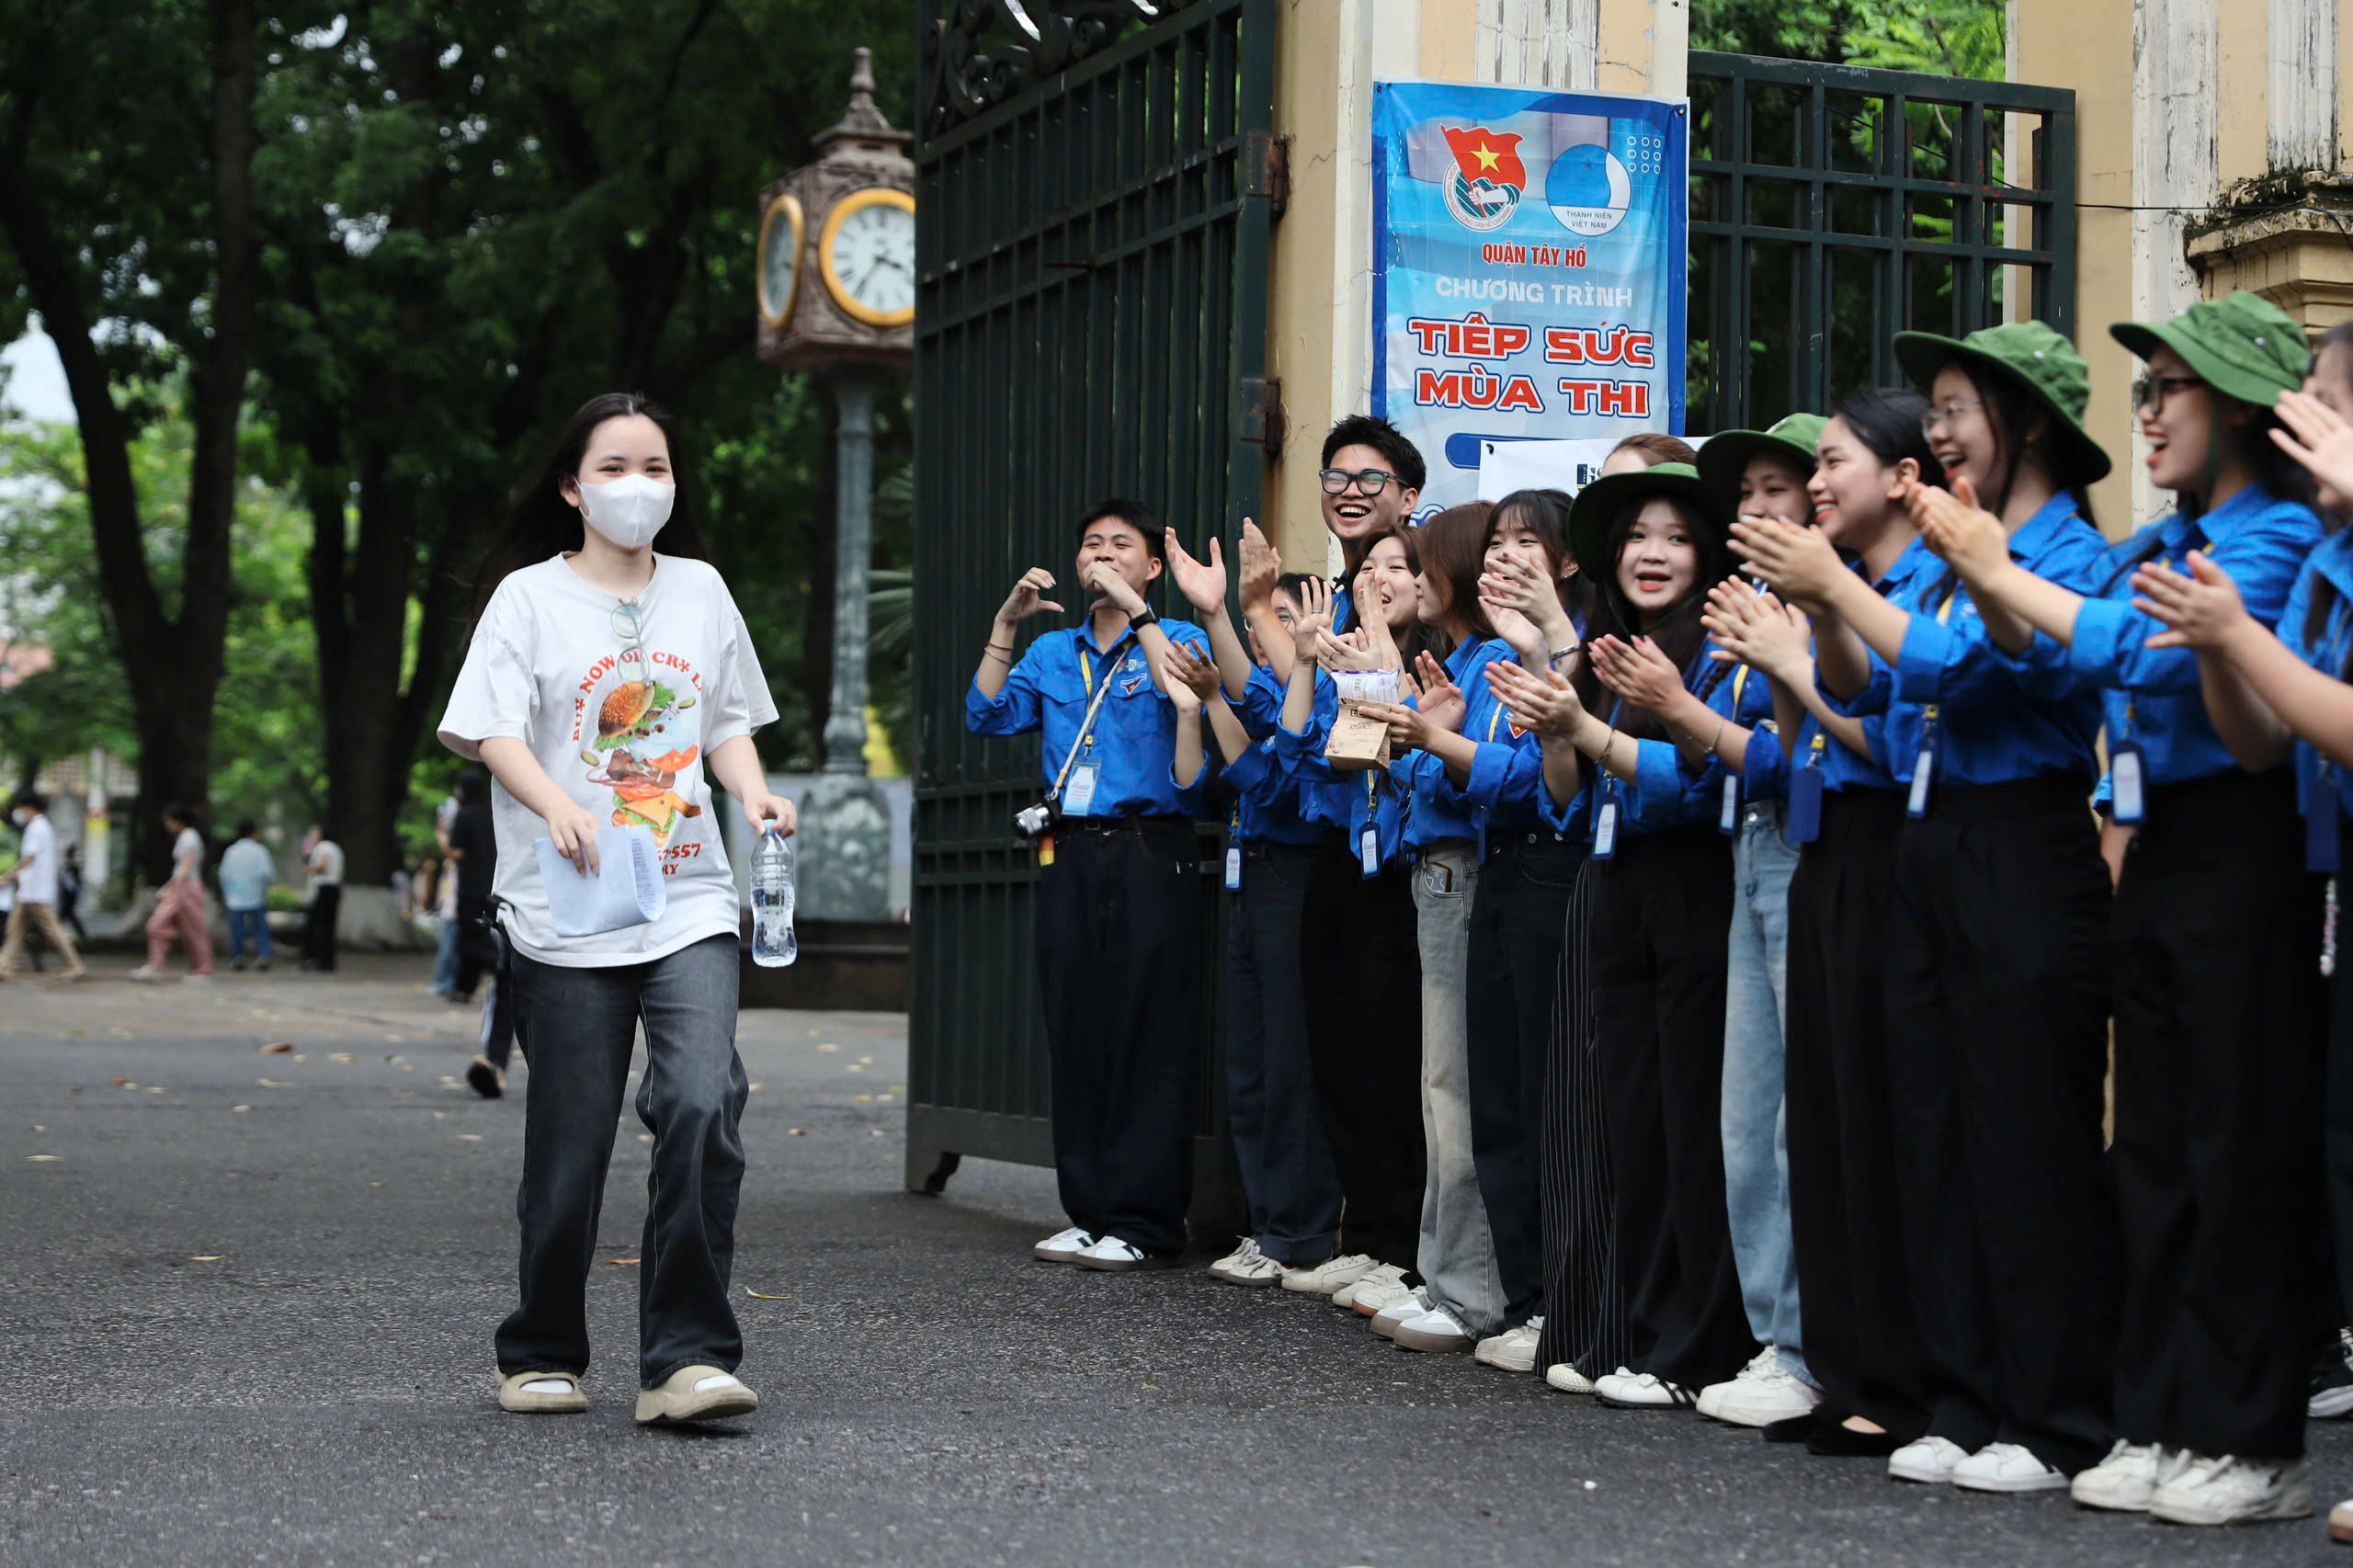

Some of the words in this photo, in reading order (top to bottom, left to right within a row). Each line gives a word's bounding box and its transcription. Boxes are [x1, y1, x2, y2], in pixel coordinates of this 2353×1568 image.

[1595, 211, 1612, 220] NIÊN
[1483, 242, 1526, 267] QUẬN
[1531, 244, 1560, 267] TÂY
[1565, 243, 1587, 268] HỒ
[1435, 277, 1544, 302] CHƯƠNG
[1552, 281, 1632, 308] TRÌNH
[1408, 312, 1530, 359] TIẾP
[1544, 322, 1654, 369] SỨC
[1415, 364, 1545, 413] MÙA
[1559, 378, 1650, 418] THI
[580, 654, 616, 695] NOW
[652, 651, 690, 673] CRY
